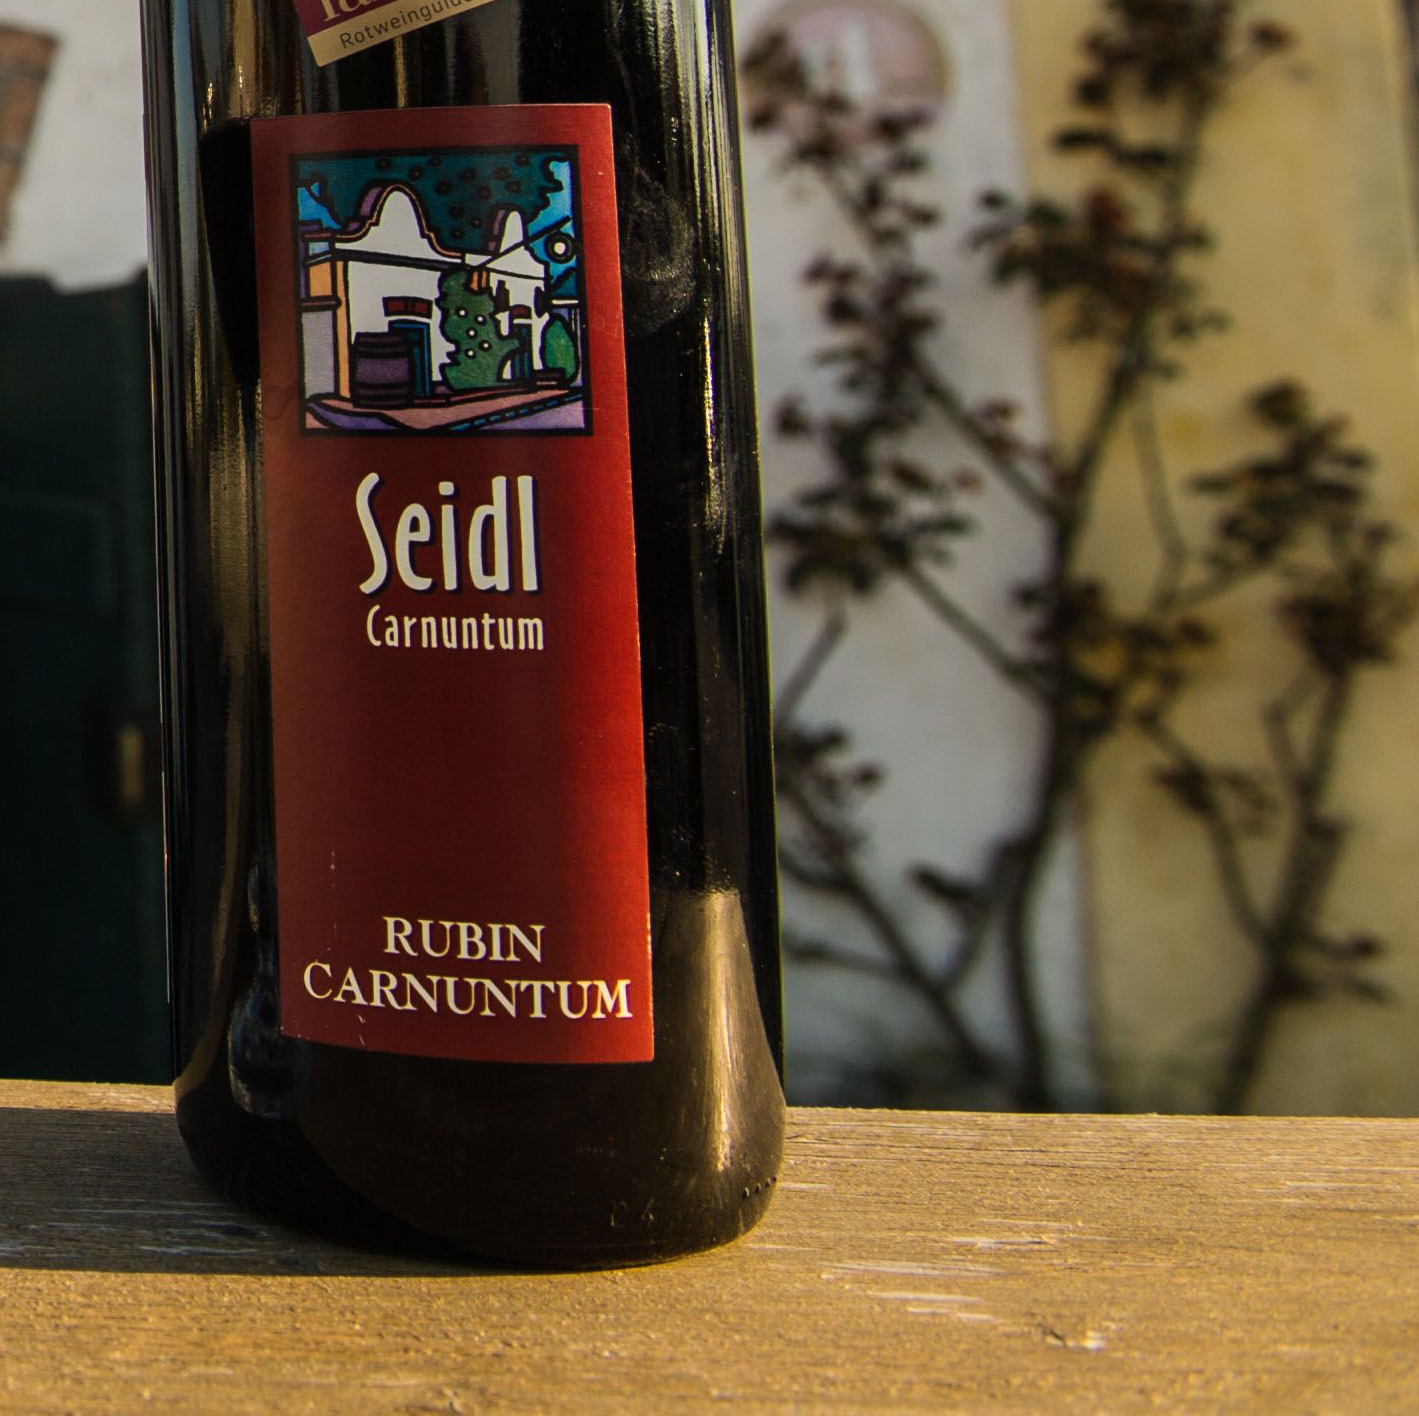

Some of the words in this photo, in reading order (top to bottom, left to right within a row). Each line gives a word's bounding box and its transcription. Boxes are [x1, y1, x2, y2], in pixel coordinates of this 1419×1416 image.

[354, 471, 540, 595] Seidl
[365, 603, 545, 651] Carnuntum
[382, 916, 547, 963] RUBIN
[302, 958, 633, 1020] CARNUNTUM
